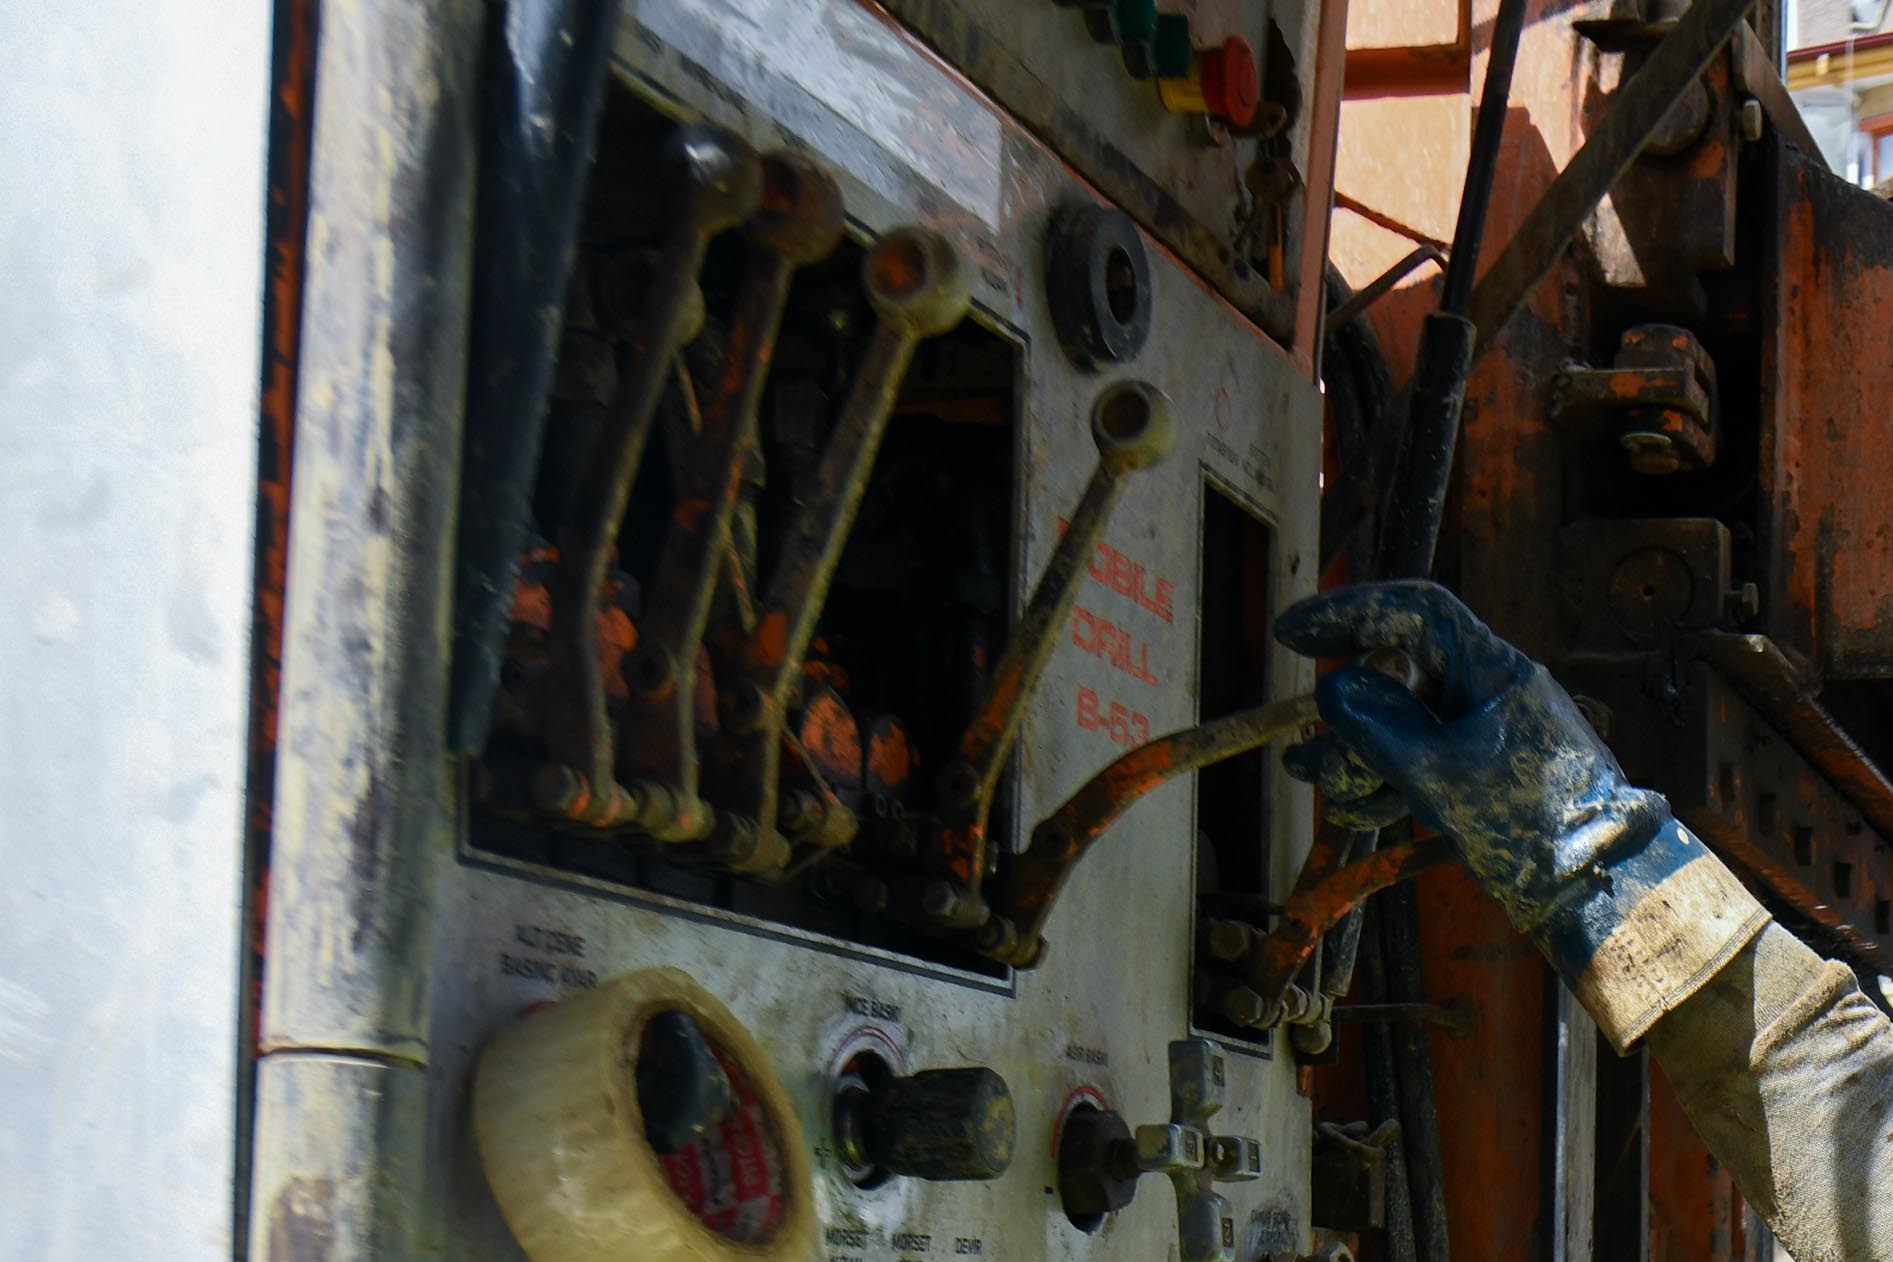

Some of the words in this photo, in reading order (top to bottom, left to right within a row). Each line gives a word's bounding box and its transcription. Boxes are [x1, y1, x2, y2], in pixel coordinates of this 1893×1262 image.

[1058, 517, 1173, 623] OBILE
[1071, 603, 1159, 686] DRILL
[891, 1233, 932, 1252] MORSET
